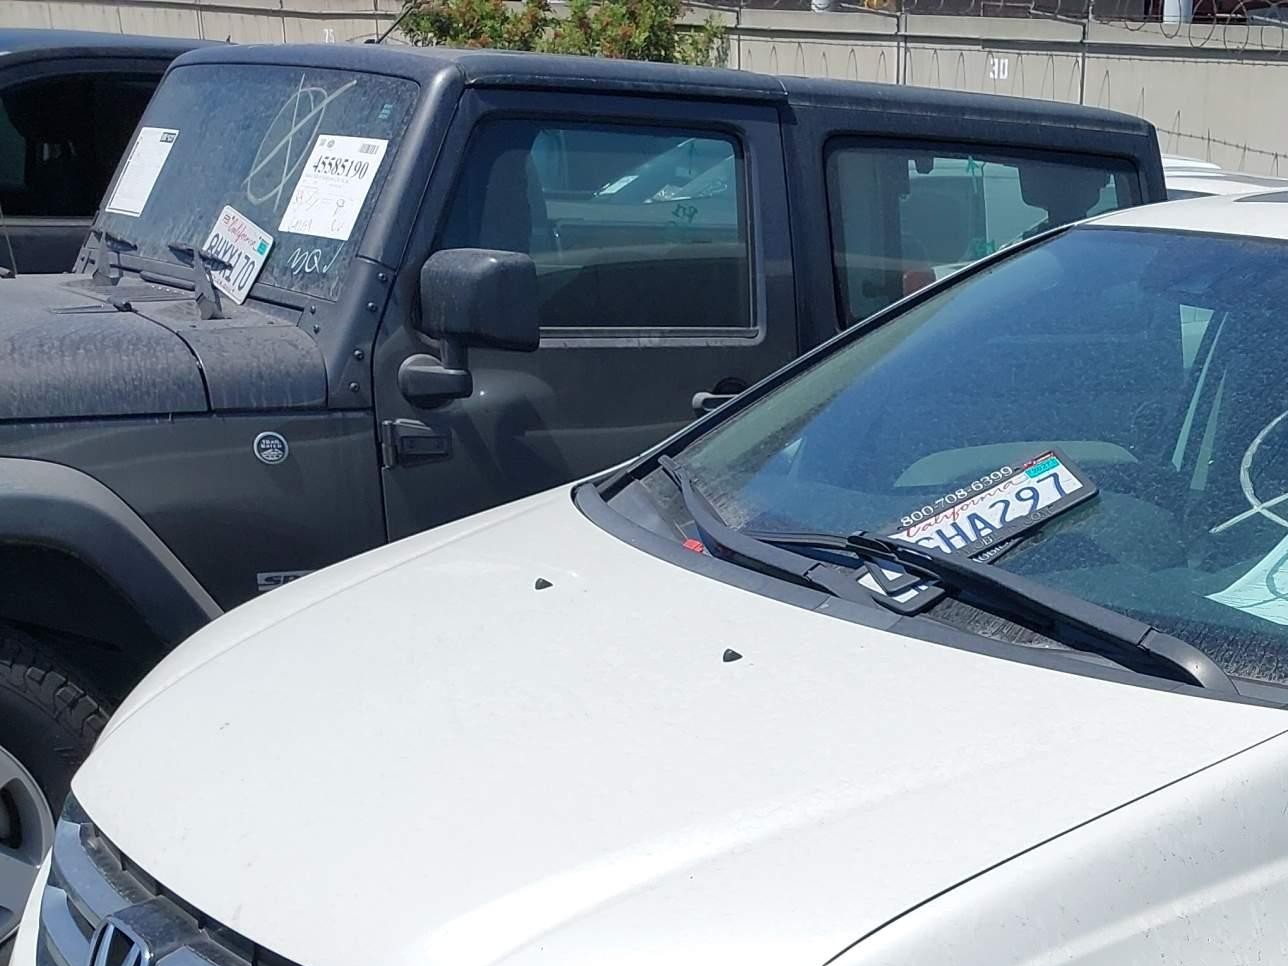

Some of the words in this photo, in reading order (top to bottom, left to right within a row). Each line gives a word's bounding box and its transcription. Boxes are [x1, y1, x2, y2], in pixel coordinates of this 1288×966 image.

[990, 58, 1009, 79] 30
[312, 155, 370, 180] 45585190
[900, 465, 1014, 528] 800-708-6399
[905, 479, 1017, 538] California
